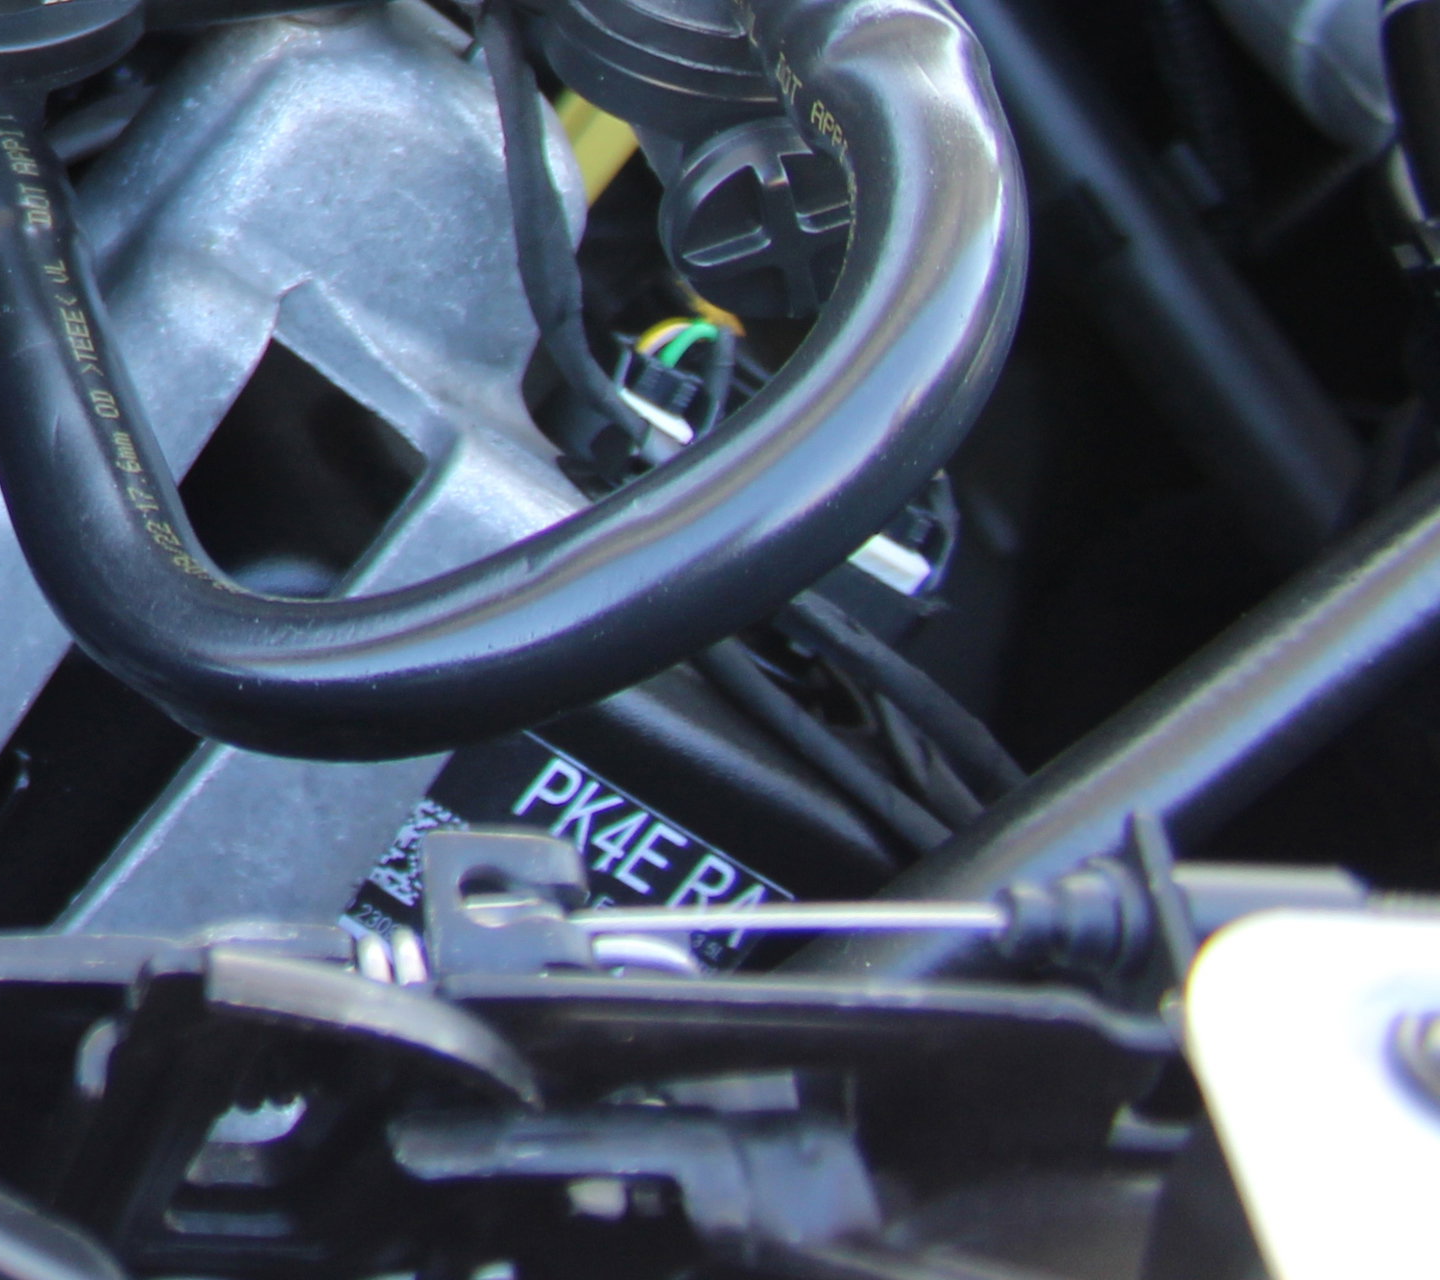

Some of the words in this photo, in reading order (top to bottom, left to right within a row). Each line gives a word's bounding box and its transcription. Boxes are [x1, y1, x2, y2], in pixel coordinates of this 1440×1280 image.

[18, 183, 54, 230] DOT
[44, 258, 70, 285] UL
[91, 389, 121, 420] OD
[511, 756, 690, 898] PK4E
